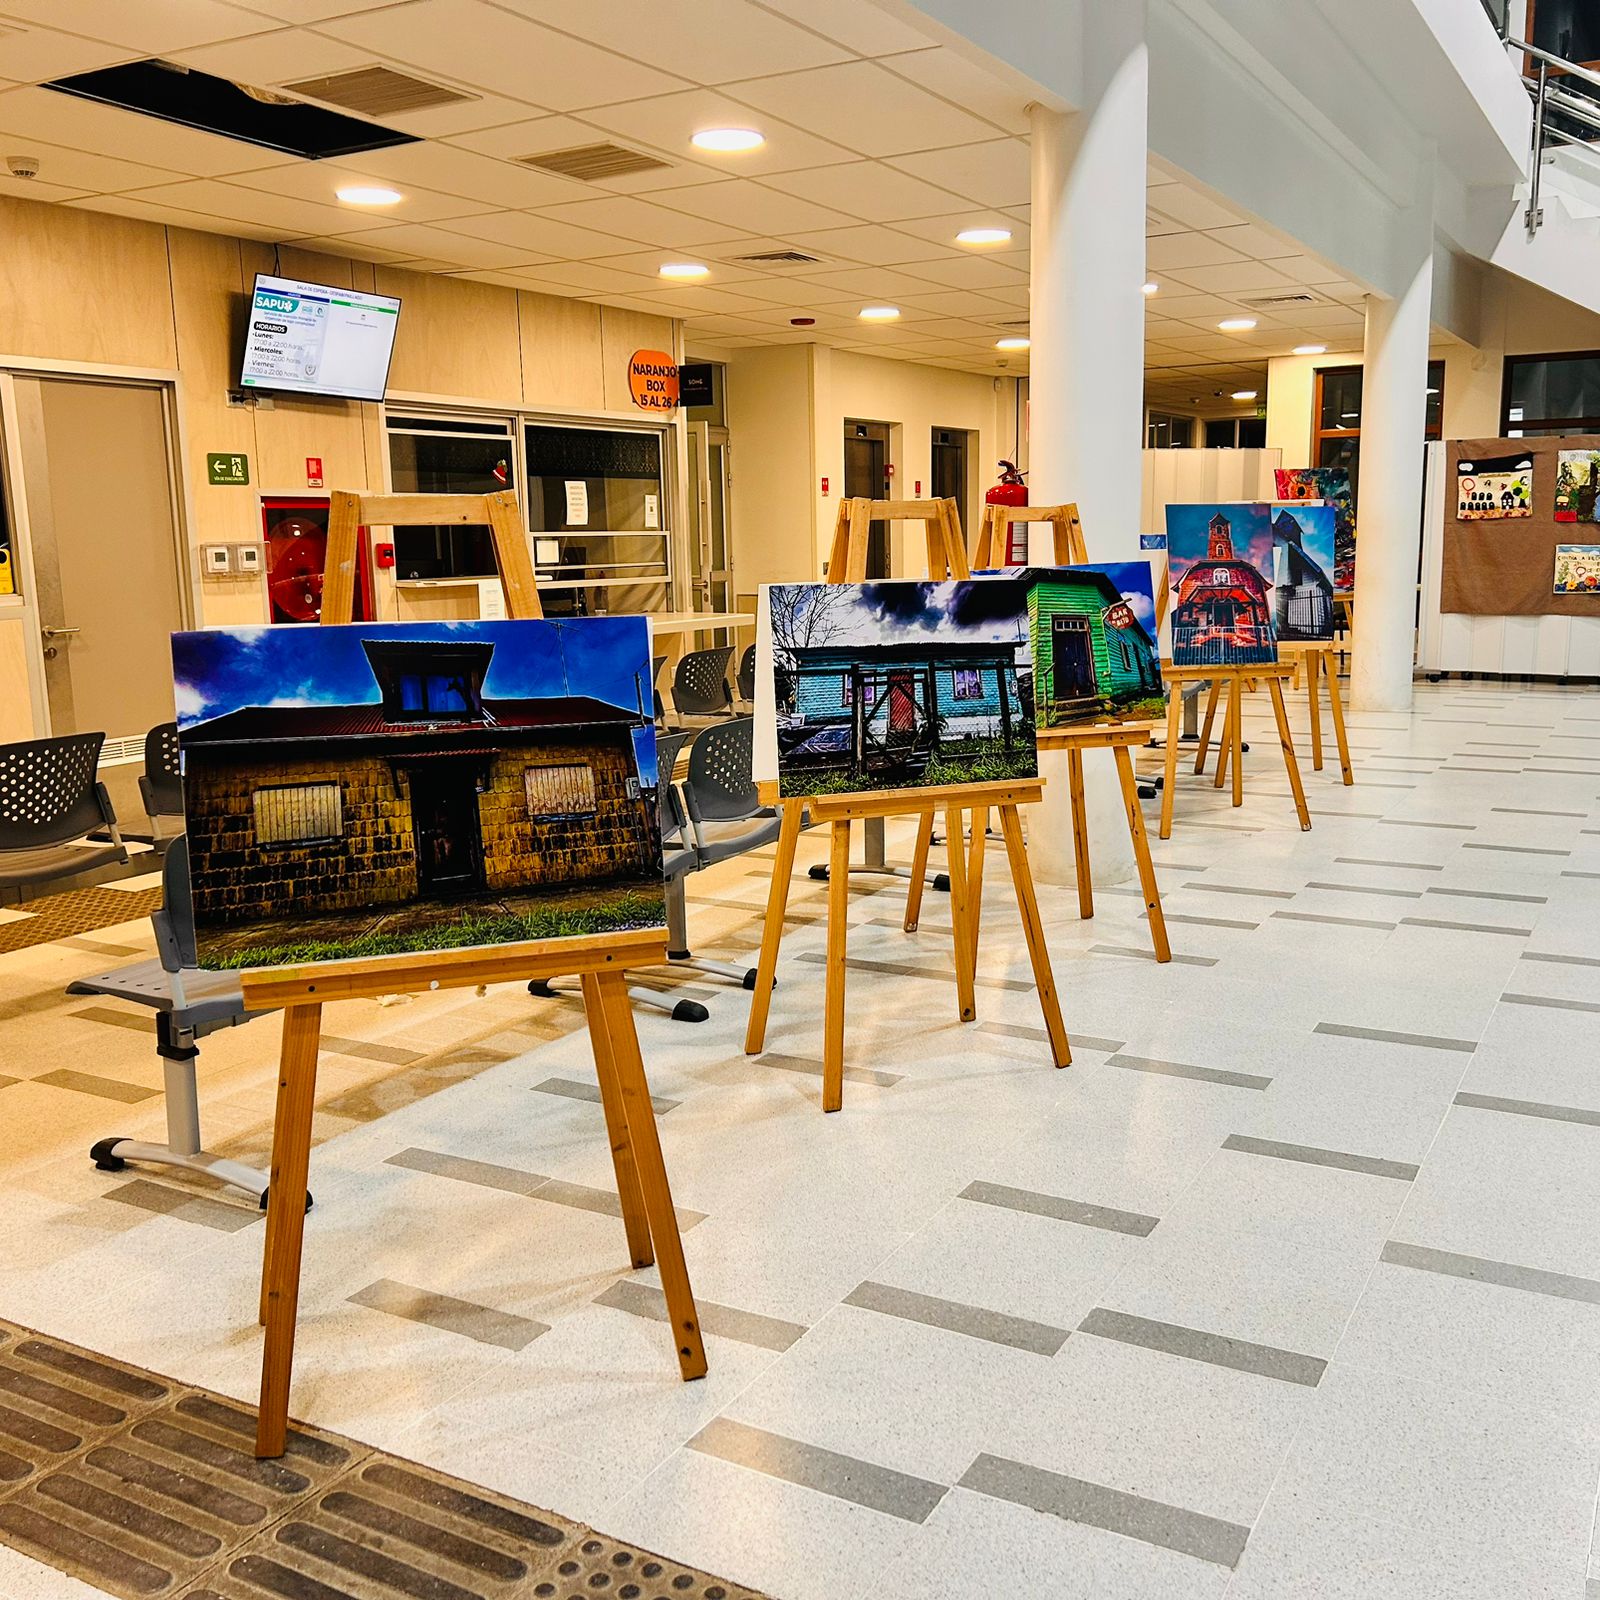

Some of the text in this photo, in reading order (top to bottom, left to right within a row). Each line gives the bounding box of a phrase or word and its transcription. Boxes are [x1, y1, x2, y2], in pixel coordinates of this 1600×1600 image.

[256, 297, 285, 310] SAPU
[256, 322, 285, 333] HORARIOS
[633, 363, 676, 378] NARANJO
[646, 379, 666, 393] BOX
[640, 394, 672, 409] 15 AL 26
[1112, 608, 1128, 620] BAR
